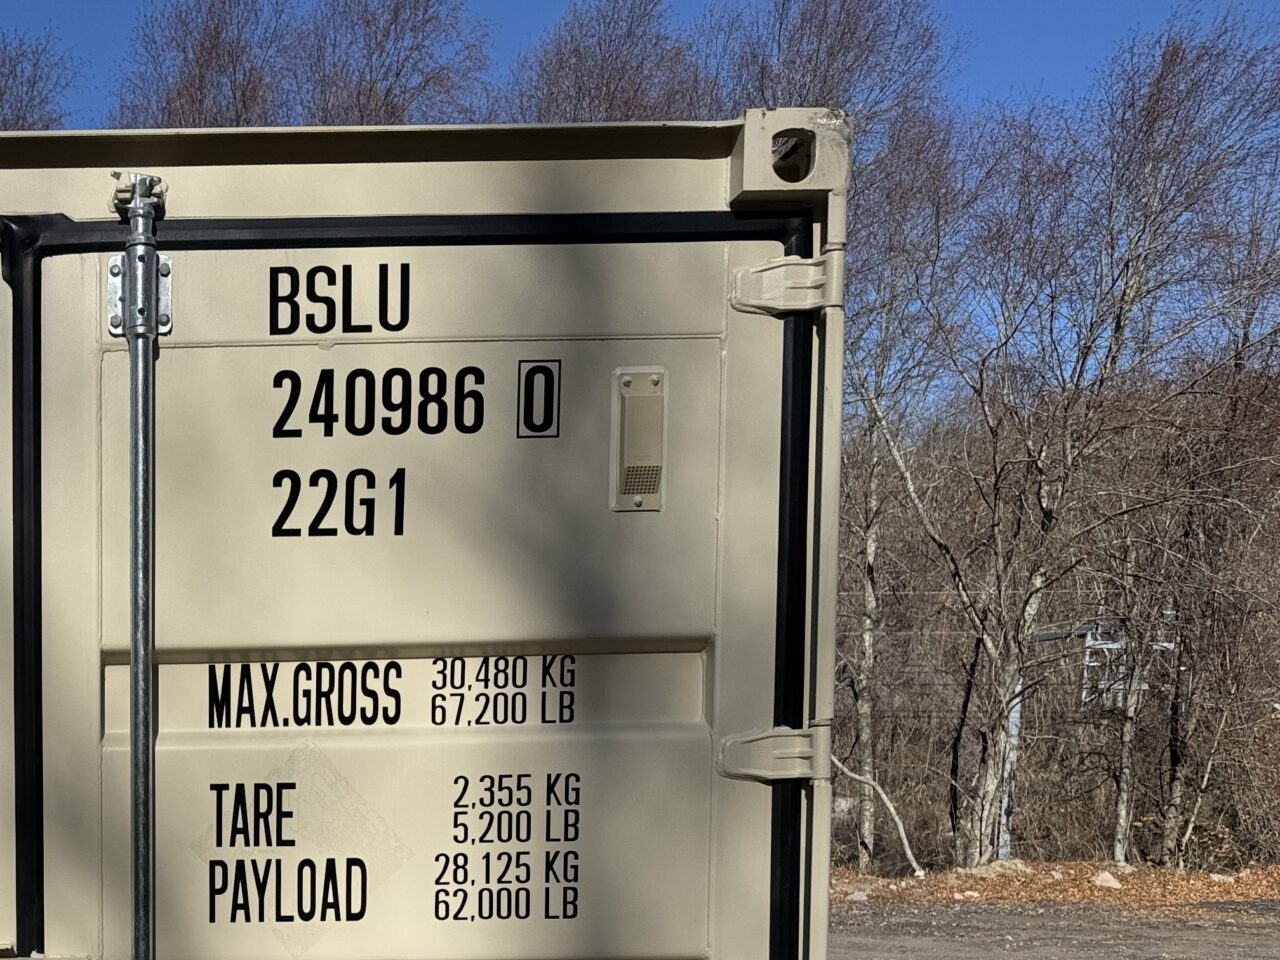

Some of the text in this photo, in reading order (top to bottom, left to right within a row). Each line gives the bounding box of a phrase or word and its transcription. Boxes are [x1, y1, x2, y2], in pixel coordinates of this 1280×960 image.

[269, 263, 411, 336] BSLU
[272, 365, 554, 438] 240986 0
[271, 467, 406, 537] 22G1
[208, 654, 576, 728] MAX.GROSS 30,480 KG
[431, 691, 575, 727] 67,200 LB
[210, 773, 581, 848] TARE 2,355 KG
[453, 809, 579, 845] 5,200 LB
[208, 850, 579, 923] PAYLOAD 28,125 KG
[434, 887, 578, 922] 62,000 LB
